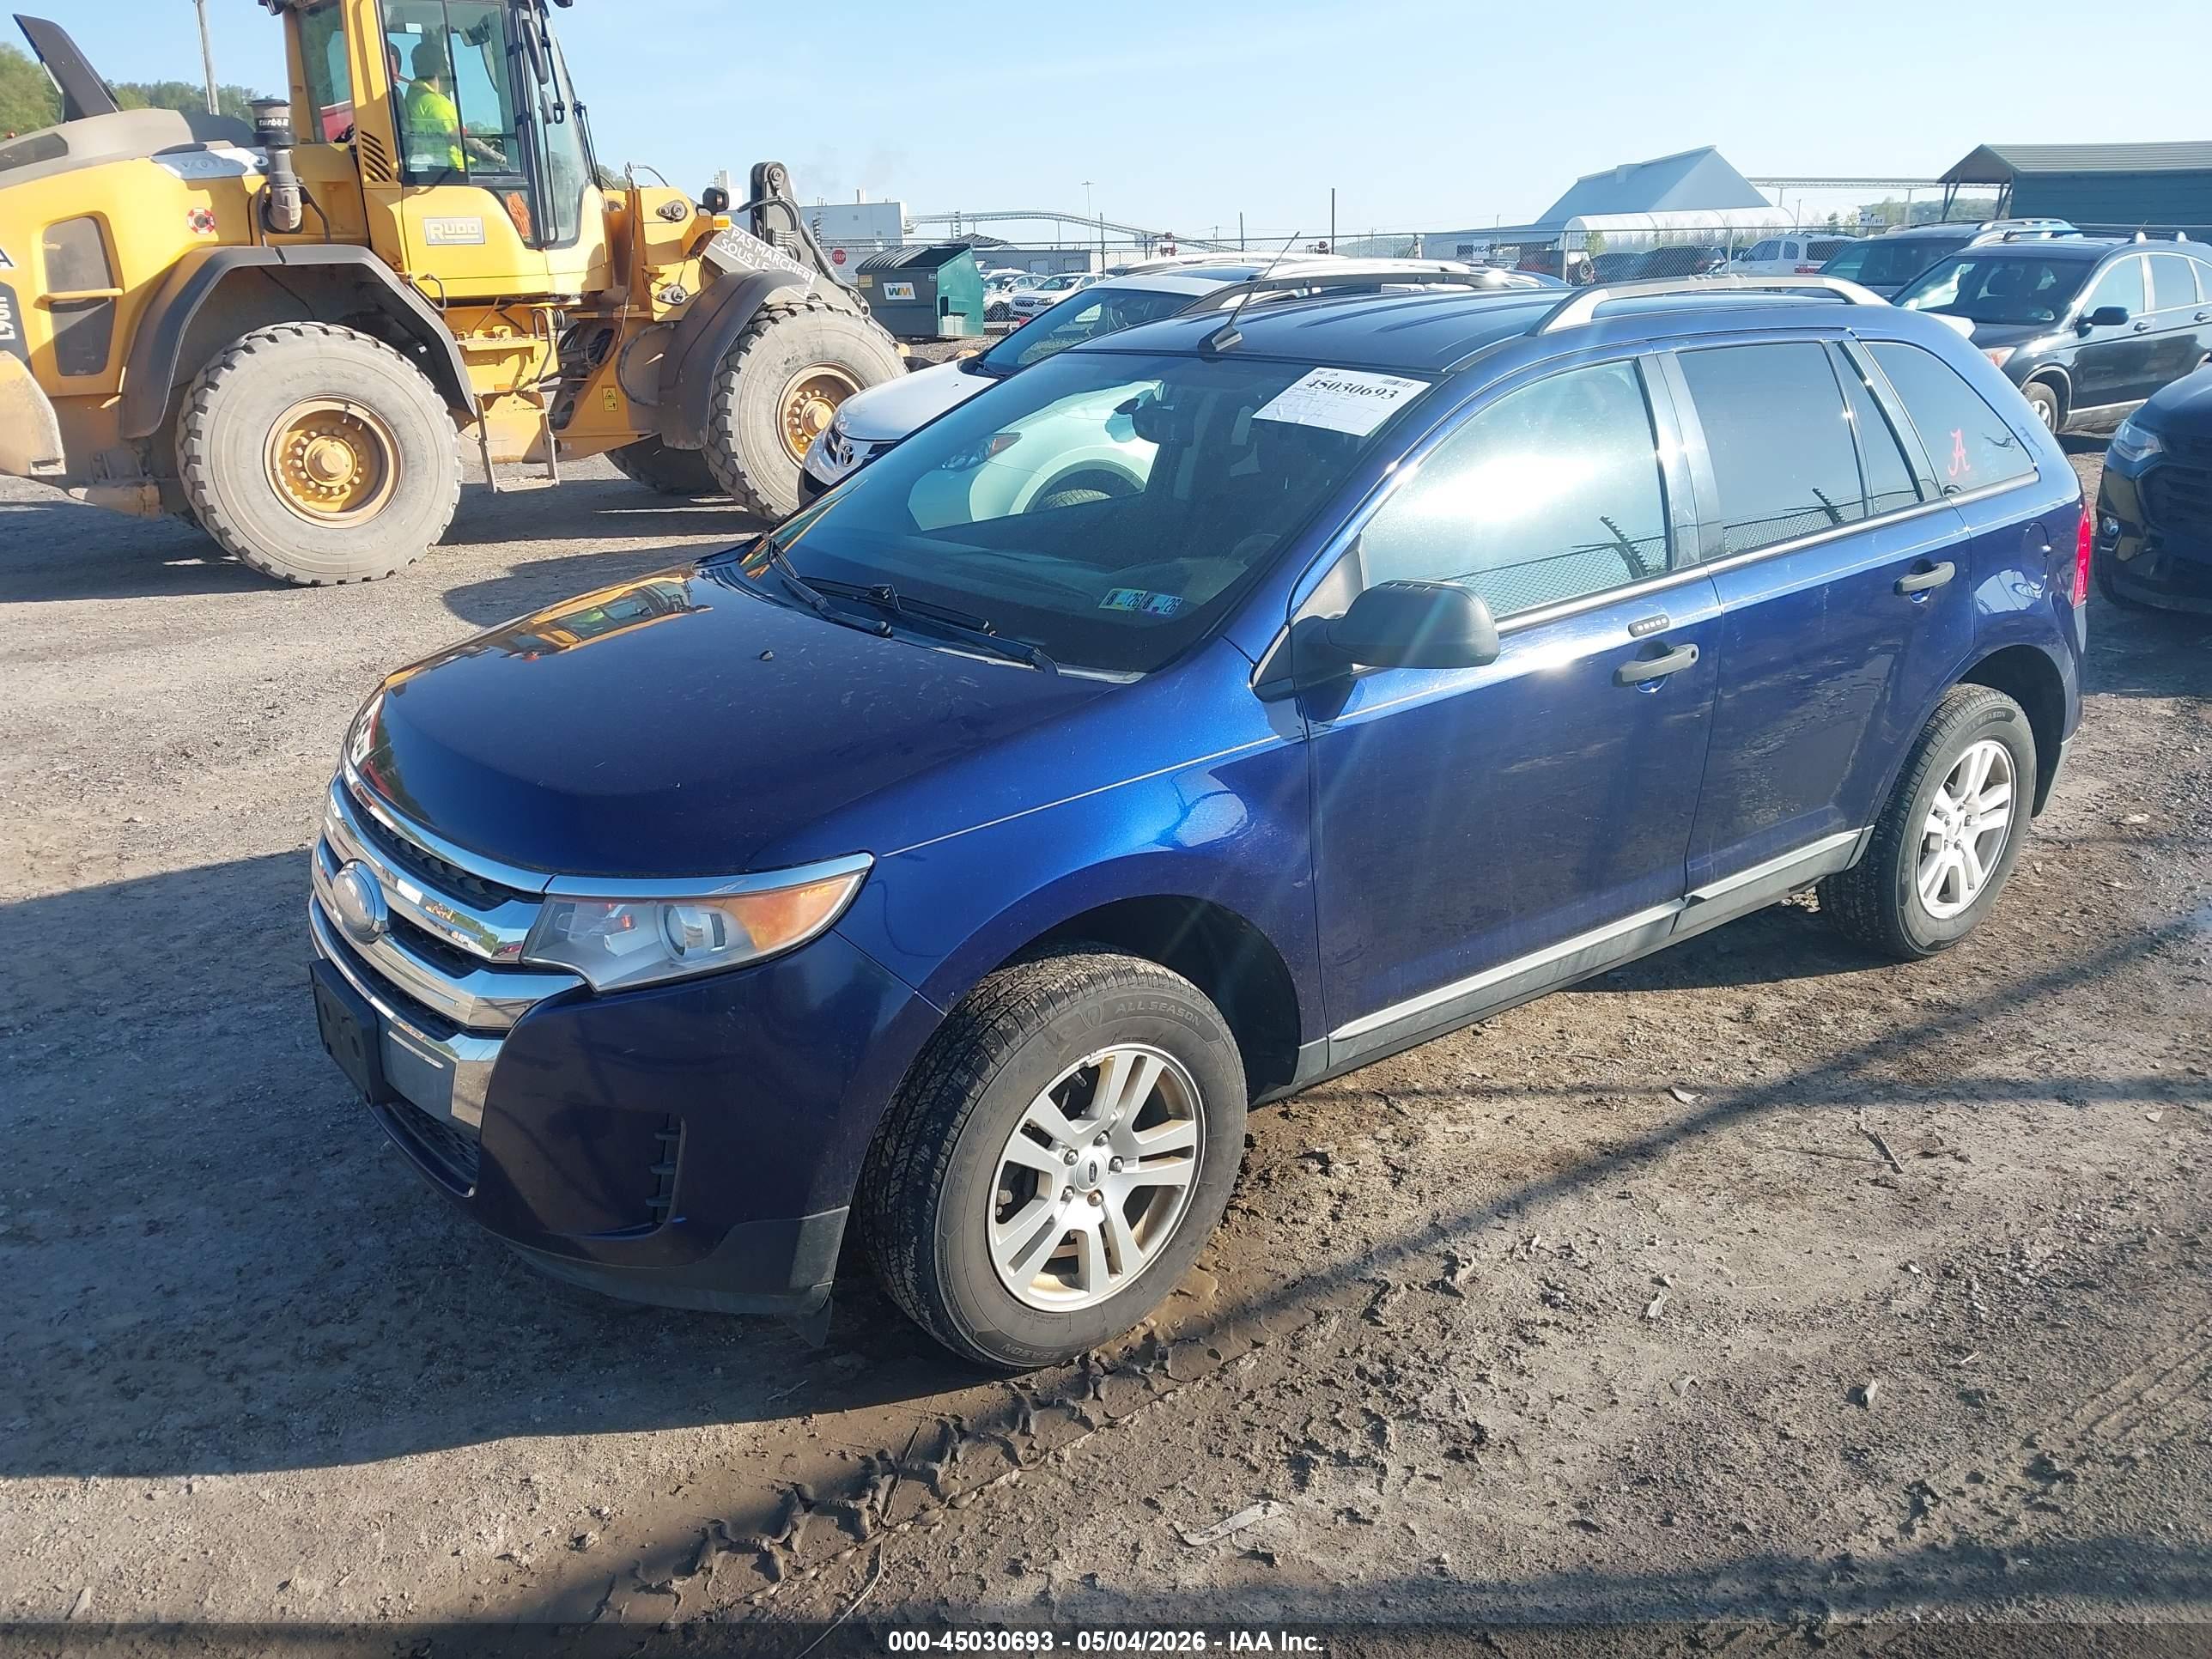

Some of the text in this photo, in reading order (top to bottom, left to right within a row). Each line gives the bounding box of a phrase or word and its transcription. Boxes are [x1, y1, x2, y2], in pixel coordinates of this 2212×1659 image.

[180, 155, 269, 170] VOLO
[720, 239, 770, 270] SOUS LE
[731, 228, 811, 282] PAS MARCHER
[887, 287, 912, 296] WM
[1305, 379, 1399, 400] 45030693
[1116, 1000, 1202, 1027] ALL SEASON
